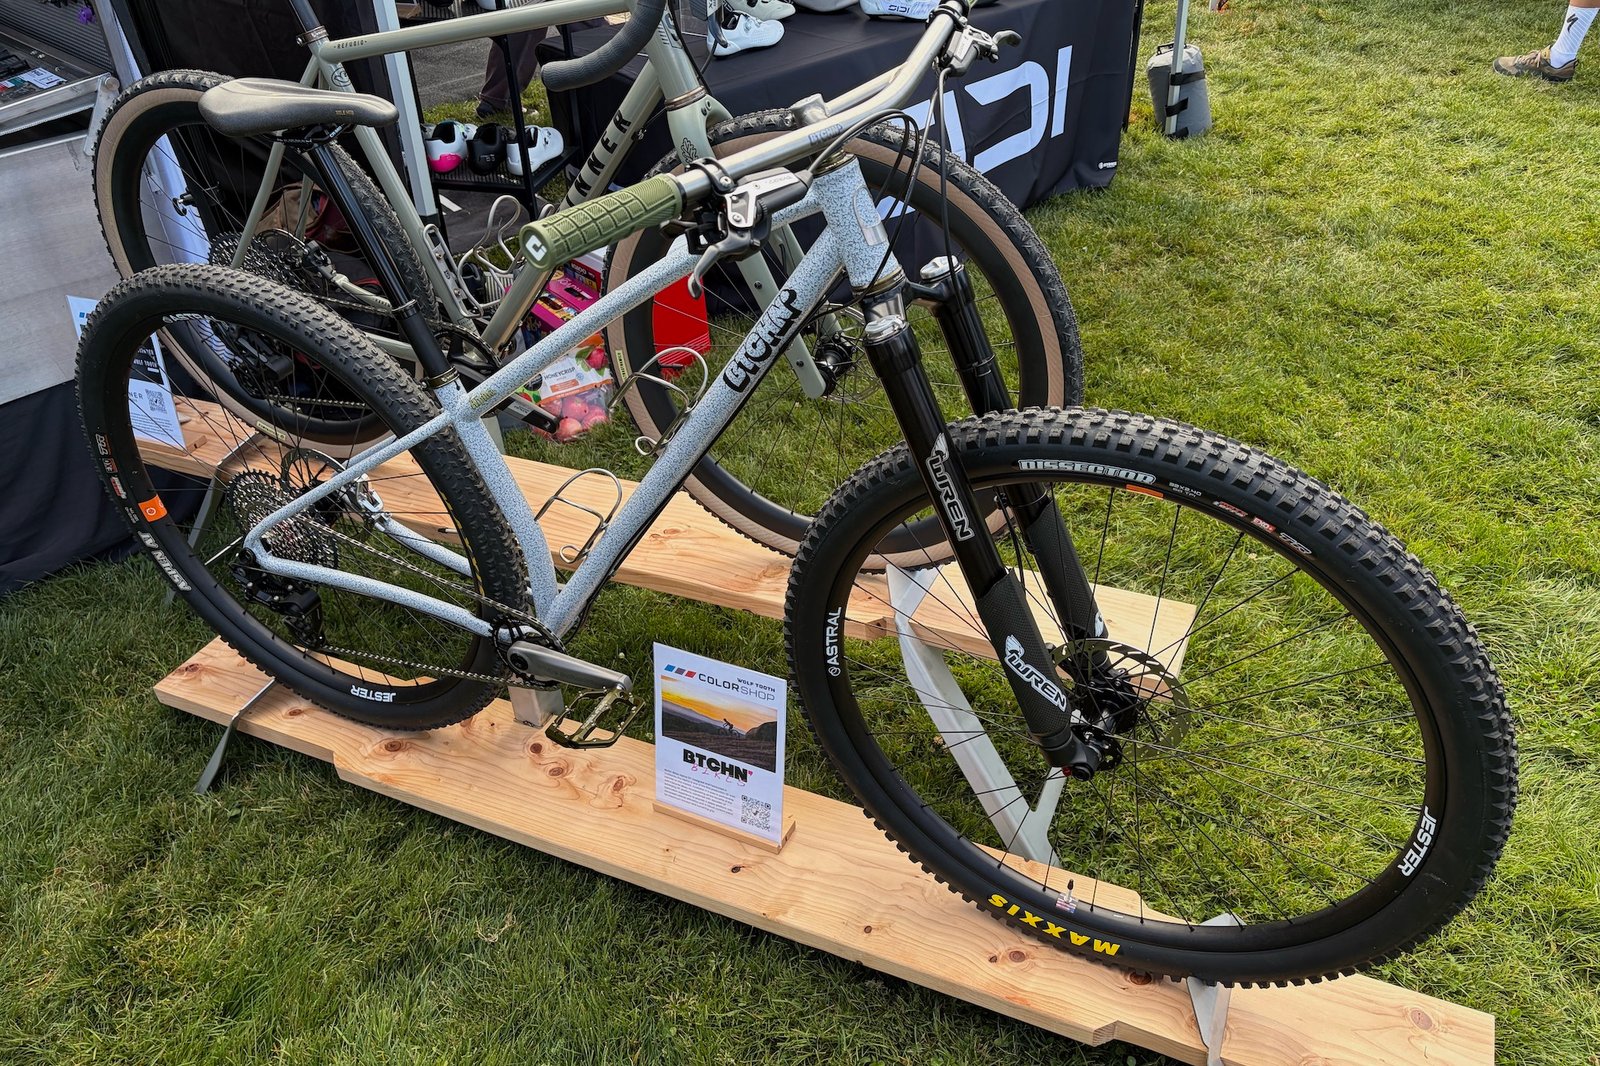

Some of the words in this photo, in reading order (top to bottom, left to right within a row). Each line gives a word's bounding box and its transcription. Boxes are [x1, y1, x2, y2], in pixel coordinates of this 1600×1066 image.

[888, 4, 911, 14] SIDI
[544, 366, 576, 380] HONEYCRISP
[1018, 459, 1156, 485] DISSECTOR
[926, 454, 975, 542] WREN
[138, 531, 159, 549] AT
[152, 550, 192, 591] ASPEN
[826, 606, 842, 666] ASTRAL
[350, 684, 396, 702] JESTER
[737, 678, 754, 687] WOLF
[755, 683, 776, 693] TOOTH
[1005, 653, 1067, 712] WREN
[1397, 805, 1437, 877] JESTER
[988, 894, 1121, 956] MAXXIS
